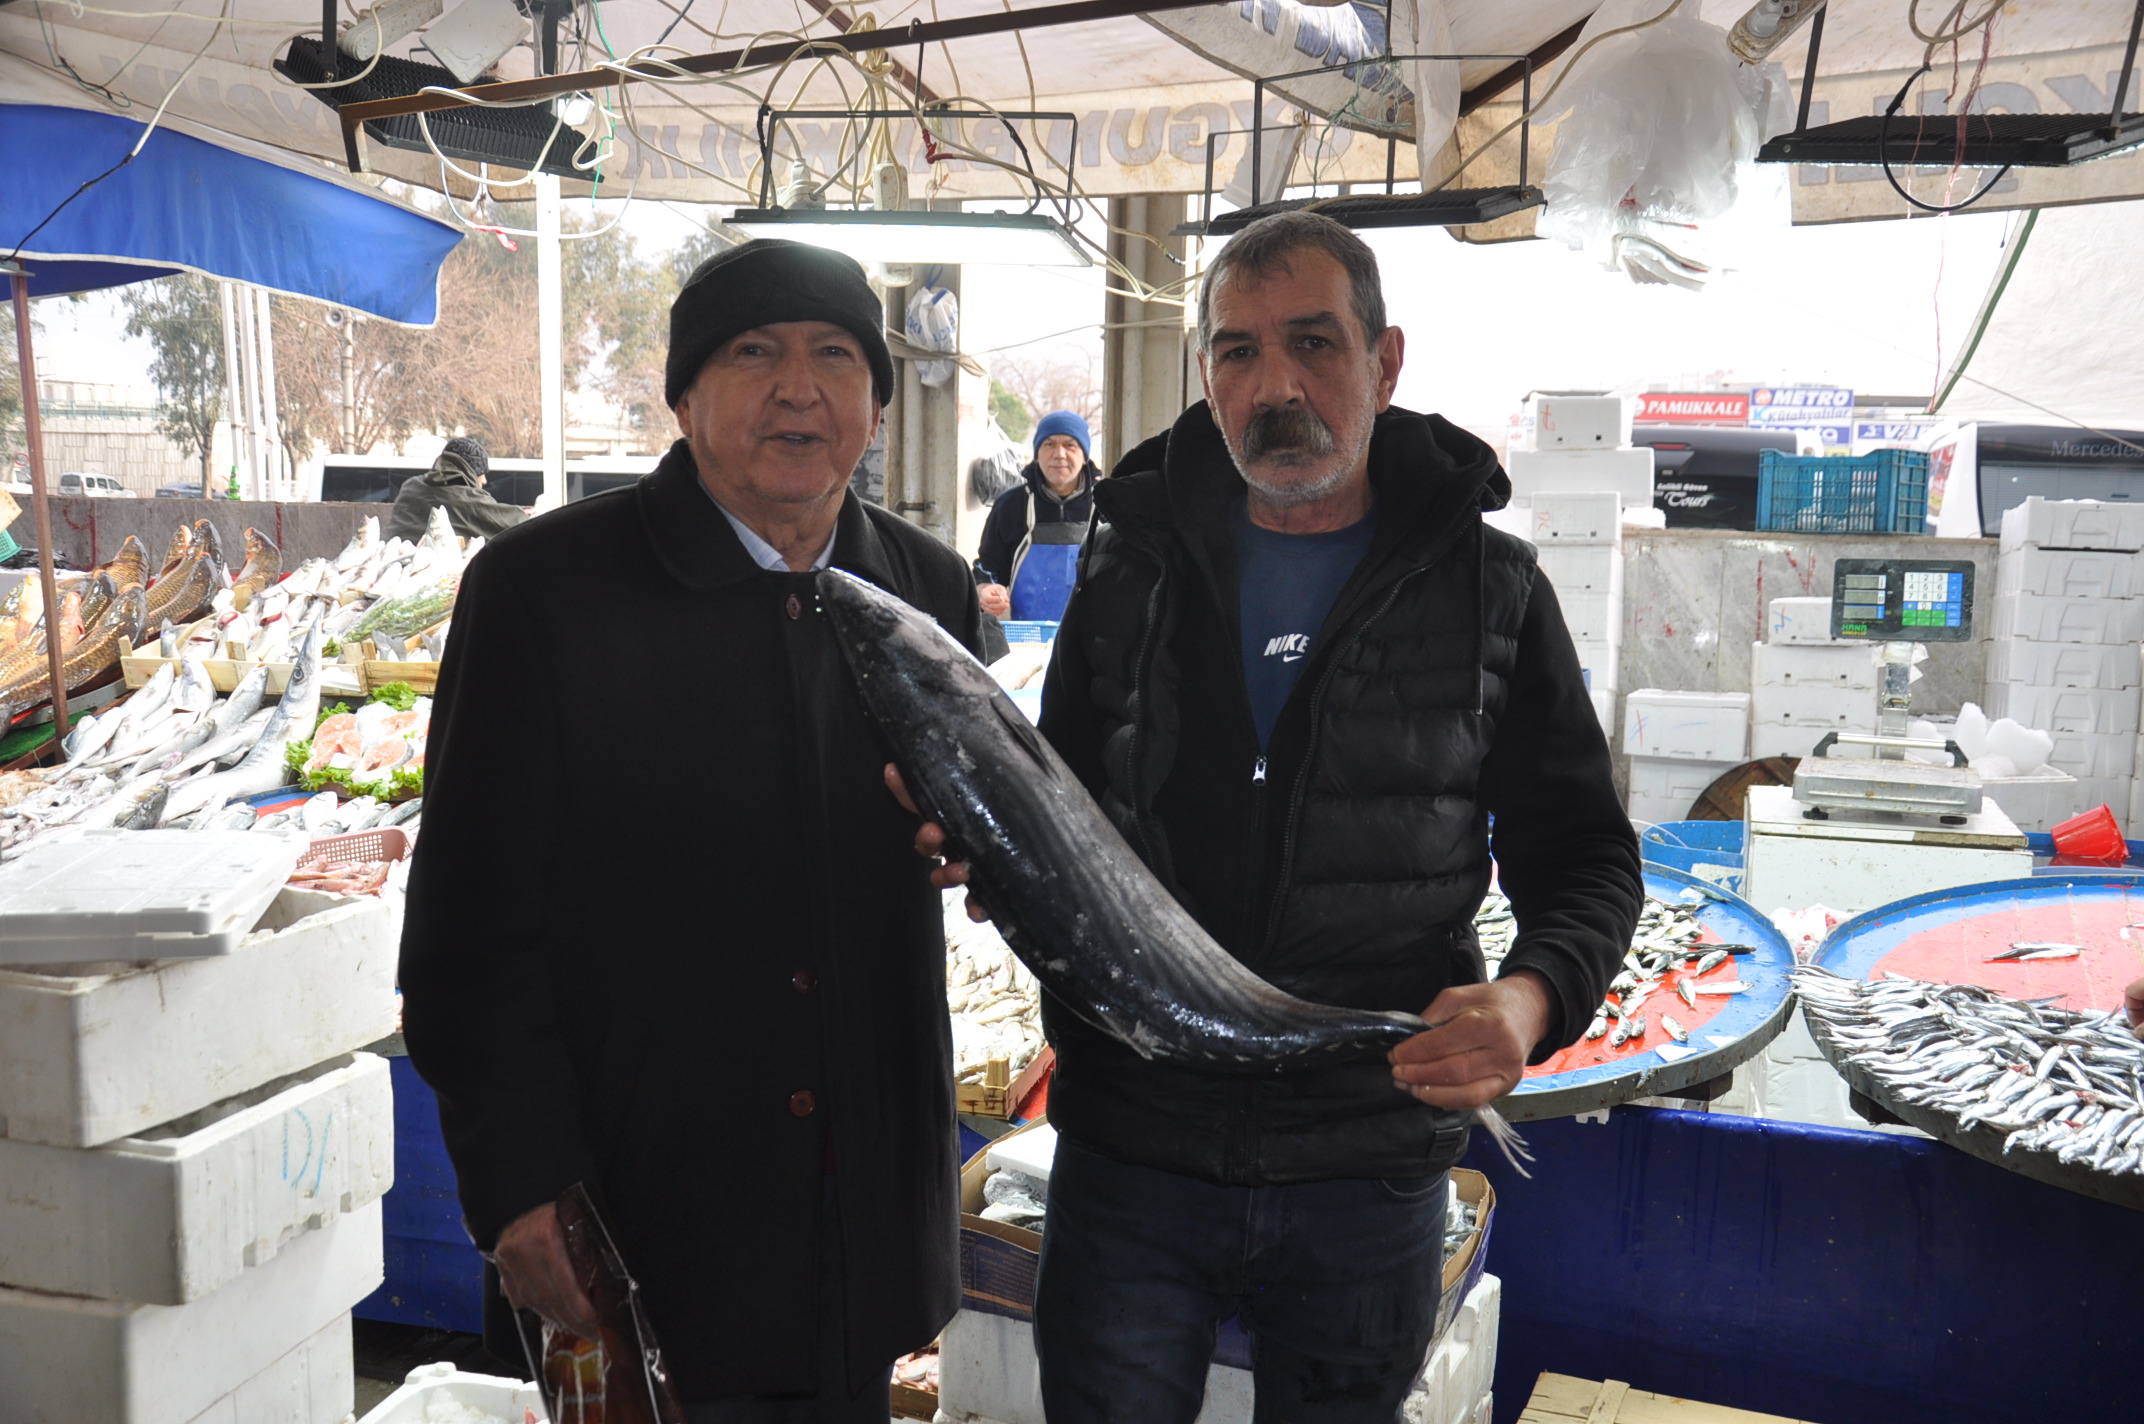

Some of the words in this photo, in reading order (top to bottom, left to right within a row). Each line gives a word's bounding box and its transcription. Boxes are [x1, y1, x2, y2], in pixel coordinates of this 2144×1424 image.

[1773, 389, 1850, 406] METRO
[1647, 400, 1744, 416] PAMUKKALE
[1263, 633, 1310, 656] NIKE
